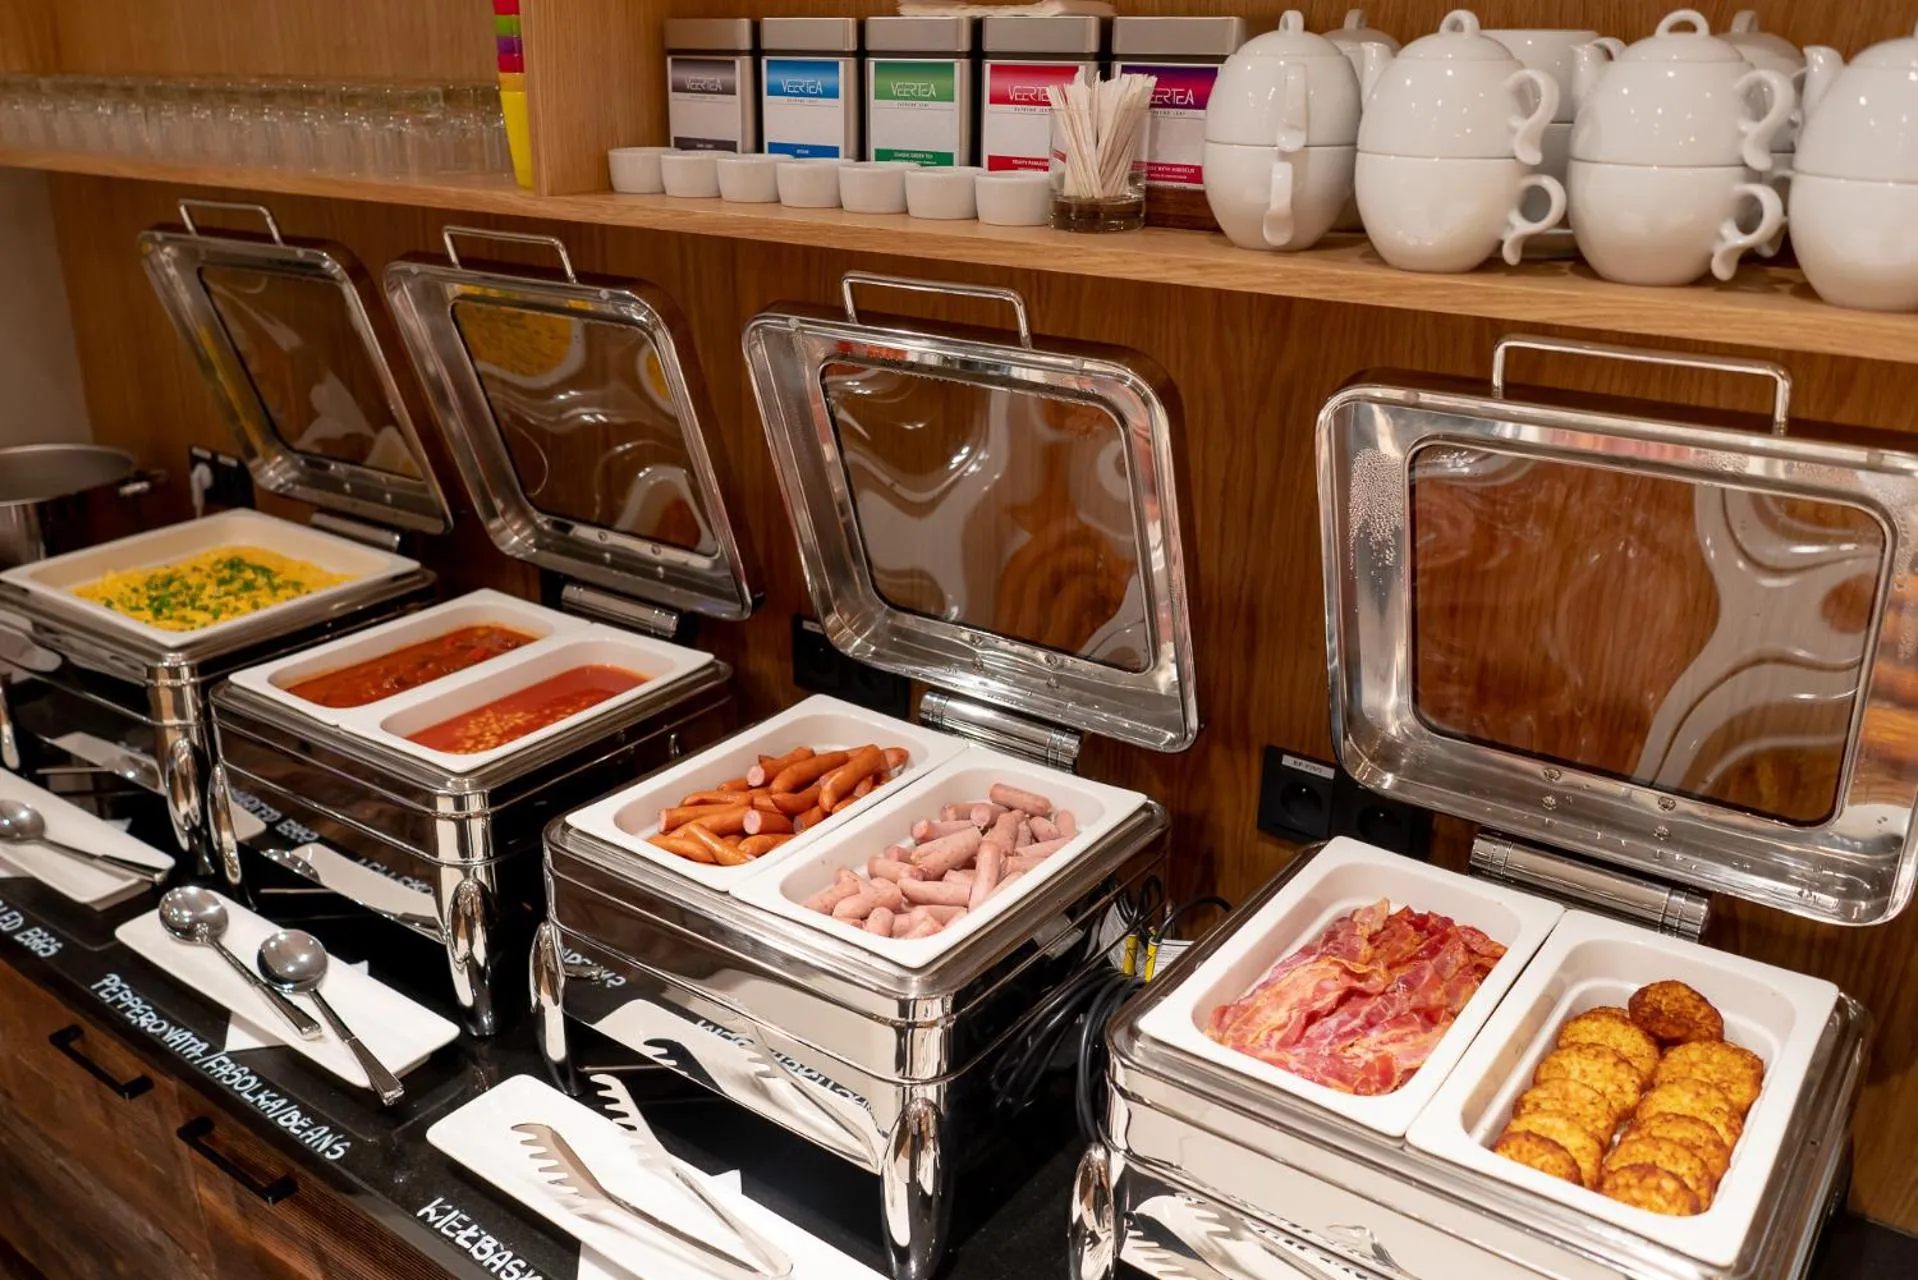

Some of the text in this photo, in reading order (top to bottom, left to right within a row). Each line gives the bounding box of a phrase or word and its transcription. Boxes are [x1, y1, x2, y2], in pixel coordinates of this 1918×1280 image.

[685, 76, 722, 92] VEERTEA
[781, 79, 823, 95] VEERTEA
[890, 81, 937, 98] VEERTEA
[1008, 84, 1050, 102] VEERTE
[14, 926, 63, 958] EGGS
